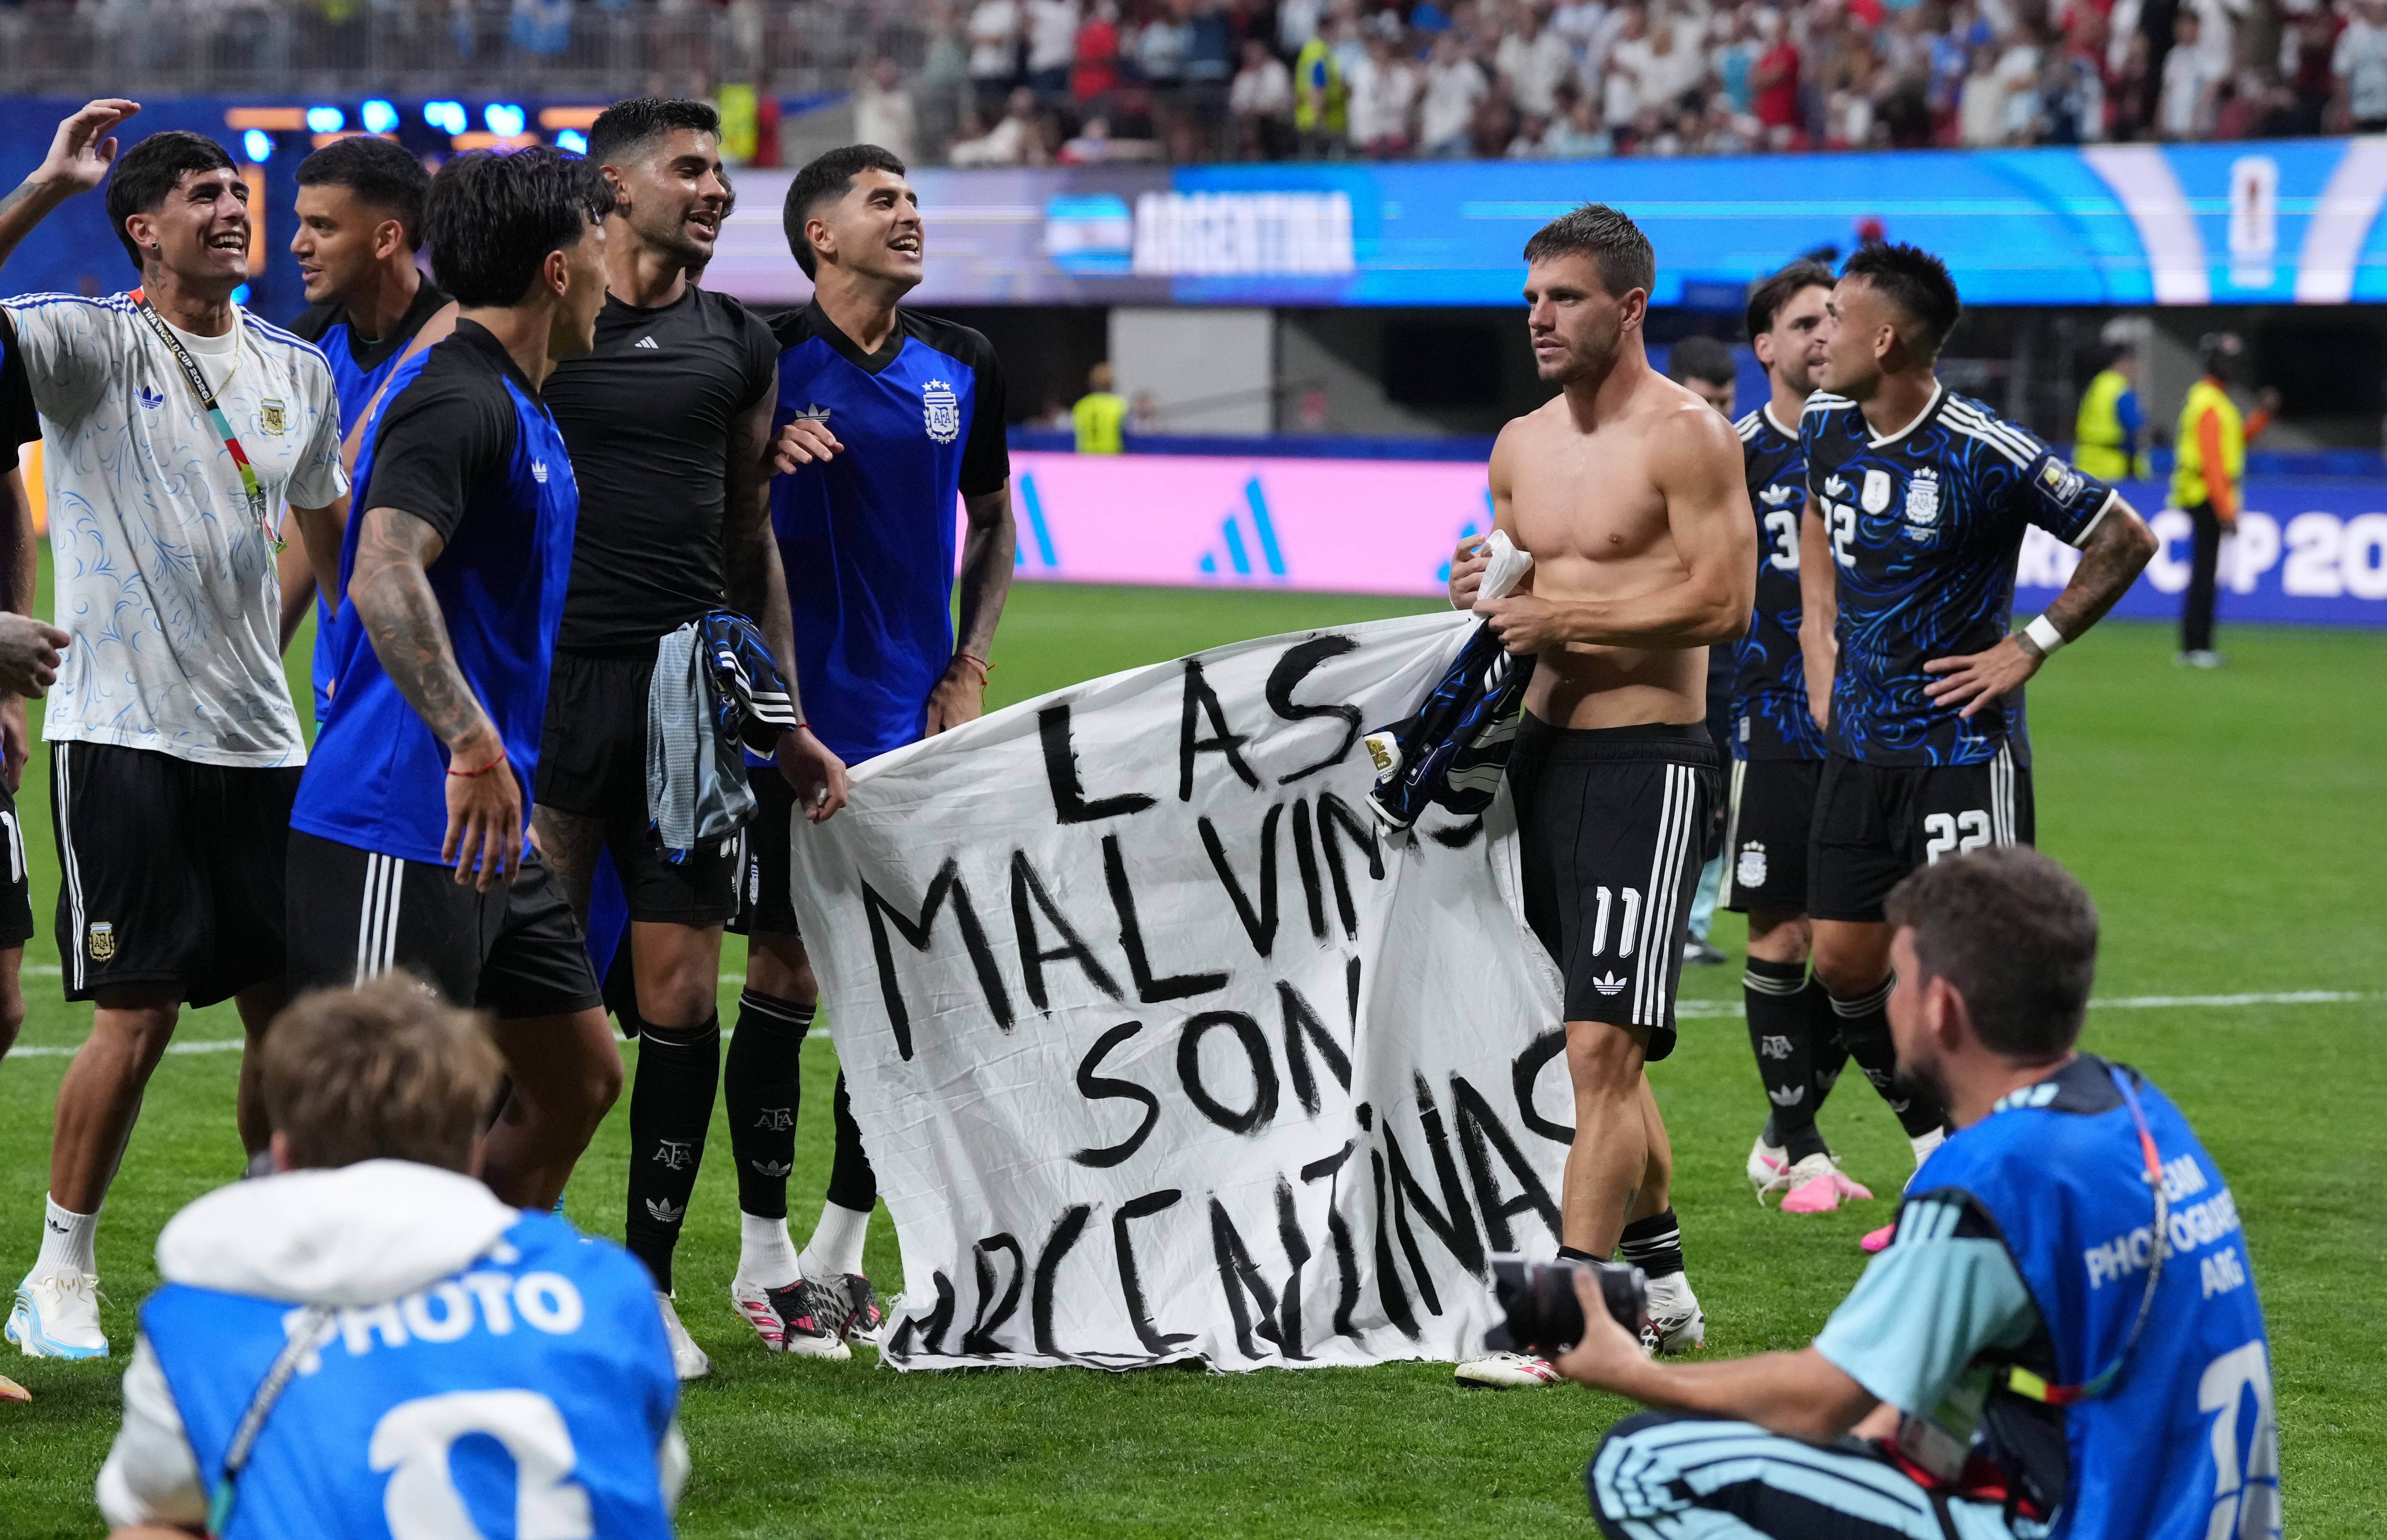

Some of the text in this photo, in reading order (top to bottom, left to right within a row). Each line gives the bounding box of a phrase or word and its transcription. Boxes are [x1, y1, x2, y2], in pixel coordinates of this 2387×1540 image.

[143, 307, 158, 326] FIFA
[178, 350, 193, 367] CUP
[189, 369, 210, 400] 2026
[934, 406, 952, 427] AFA
[1764, 510, 1800, 570] 3
[2145, 509, 2281, 594] CP
[1038, 633, 1364, 825] LAS
[1924, 809, 1992, 867] 22
[94, 933, 108, 950] AFA
[860, 791, 1485, 1061] MALVIN
[1592, 887, 1641, 958] 11
[1068, 956, 1361, 1169] SON
[754, 1108, 793, 1131] AFA
[653, 1139, 693, 1170] AFA
[2141, 1153, 2208, 1203] EAM
